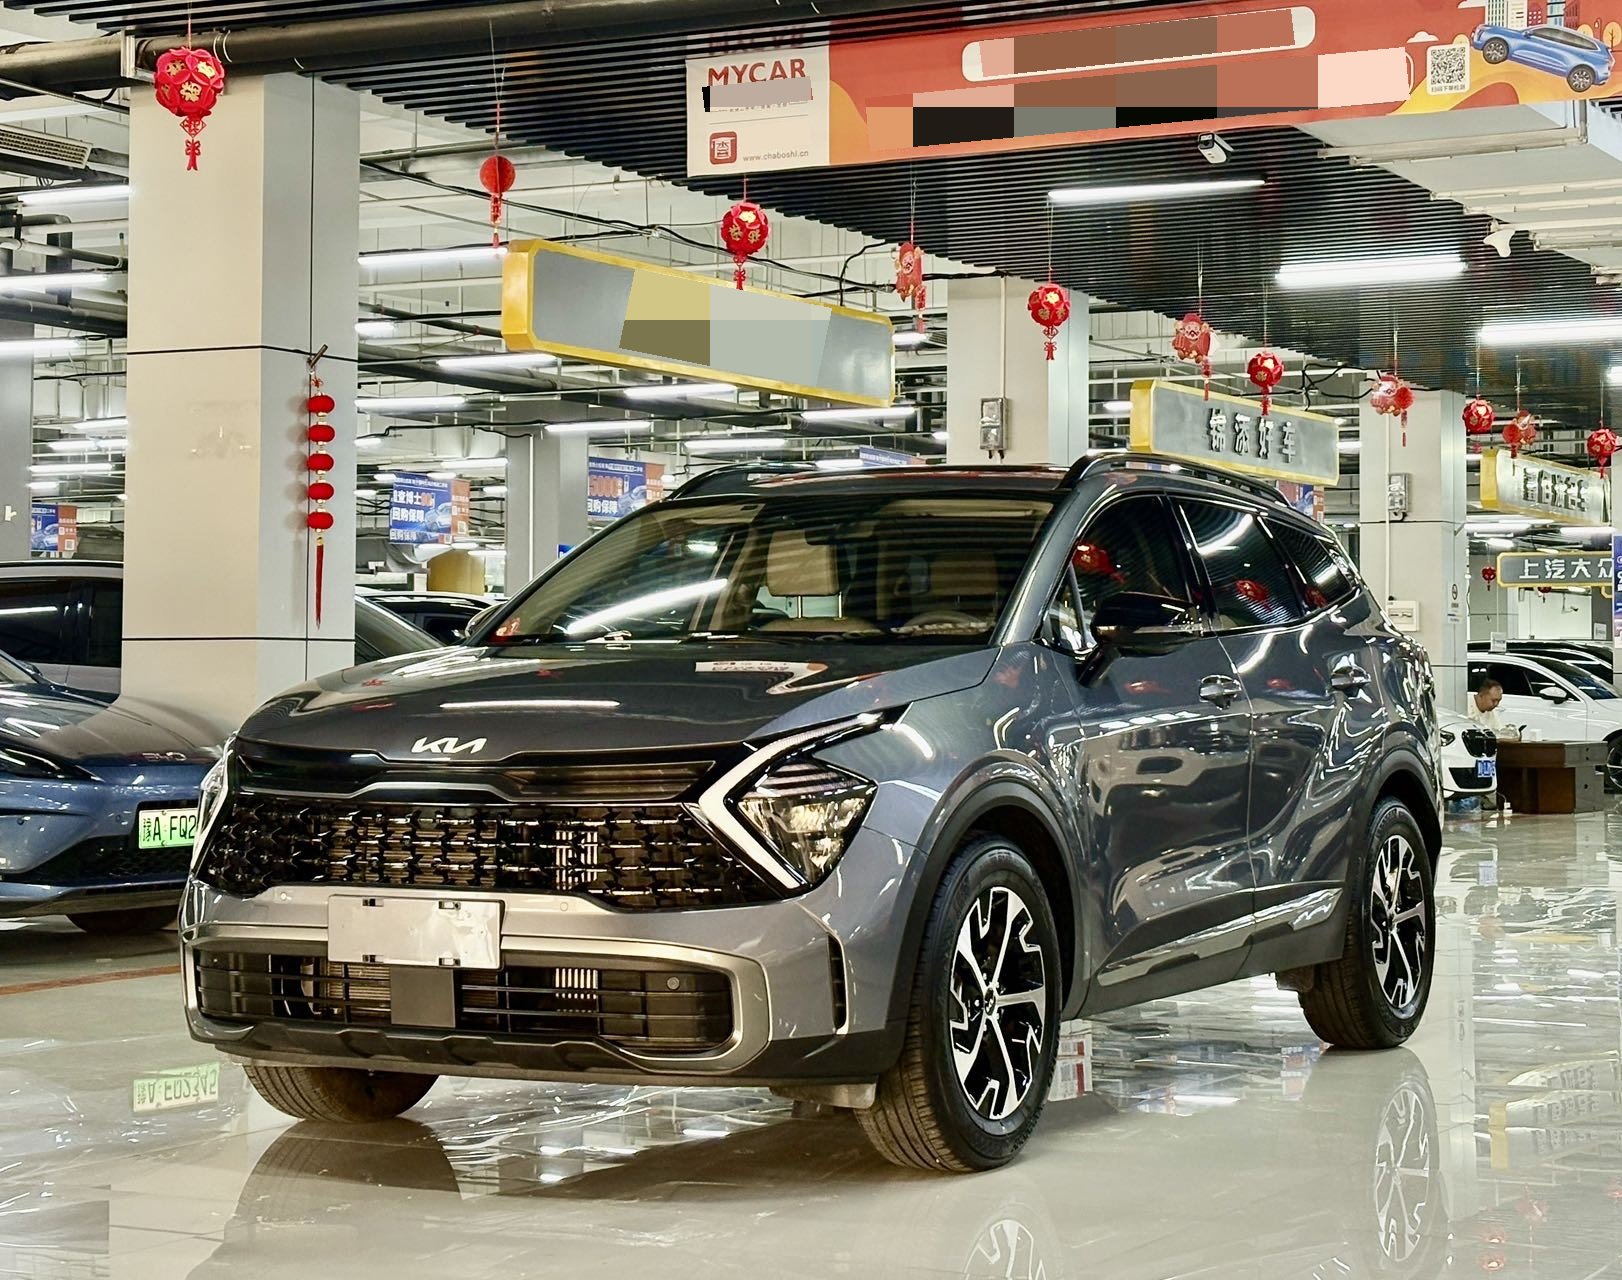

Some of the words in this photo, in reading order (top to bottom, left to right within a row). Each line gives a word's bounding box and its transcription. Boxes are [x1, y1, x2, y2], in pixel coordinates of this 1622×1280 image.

[707, 57, 806, 86] MYCAR
[742, 150, 809, 162] www.chaboshi.cn
[1519, 558, 1613, 580] 上汽大众
